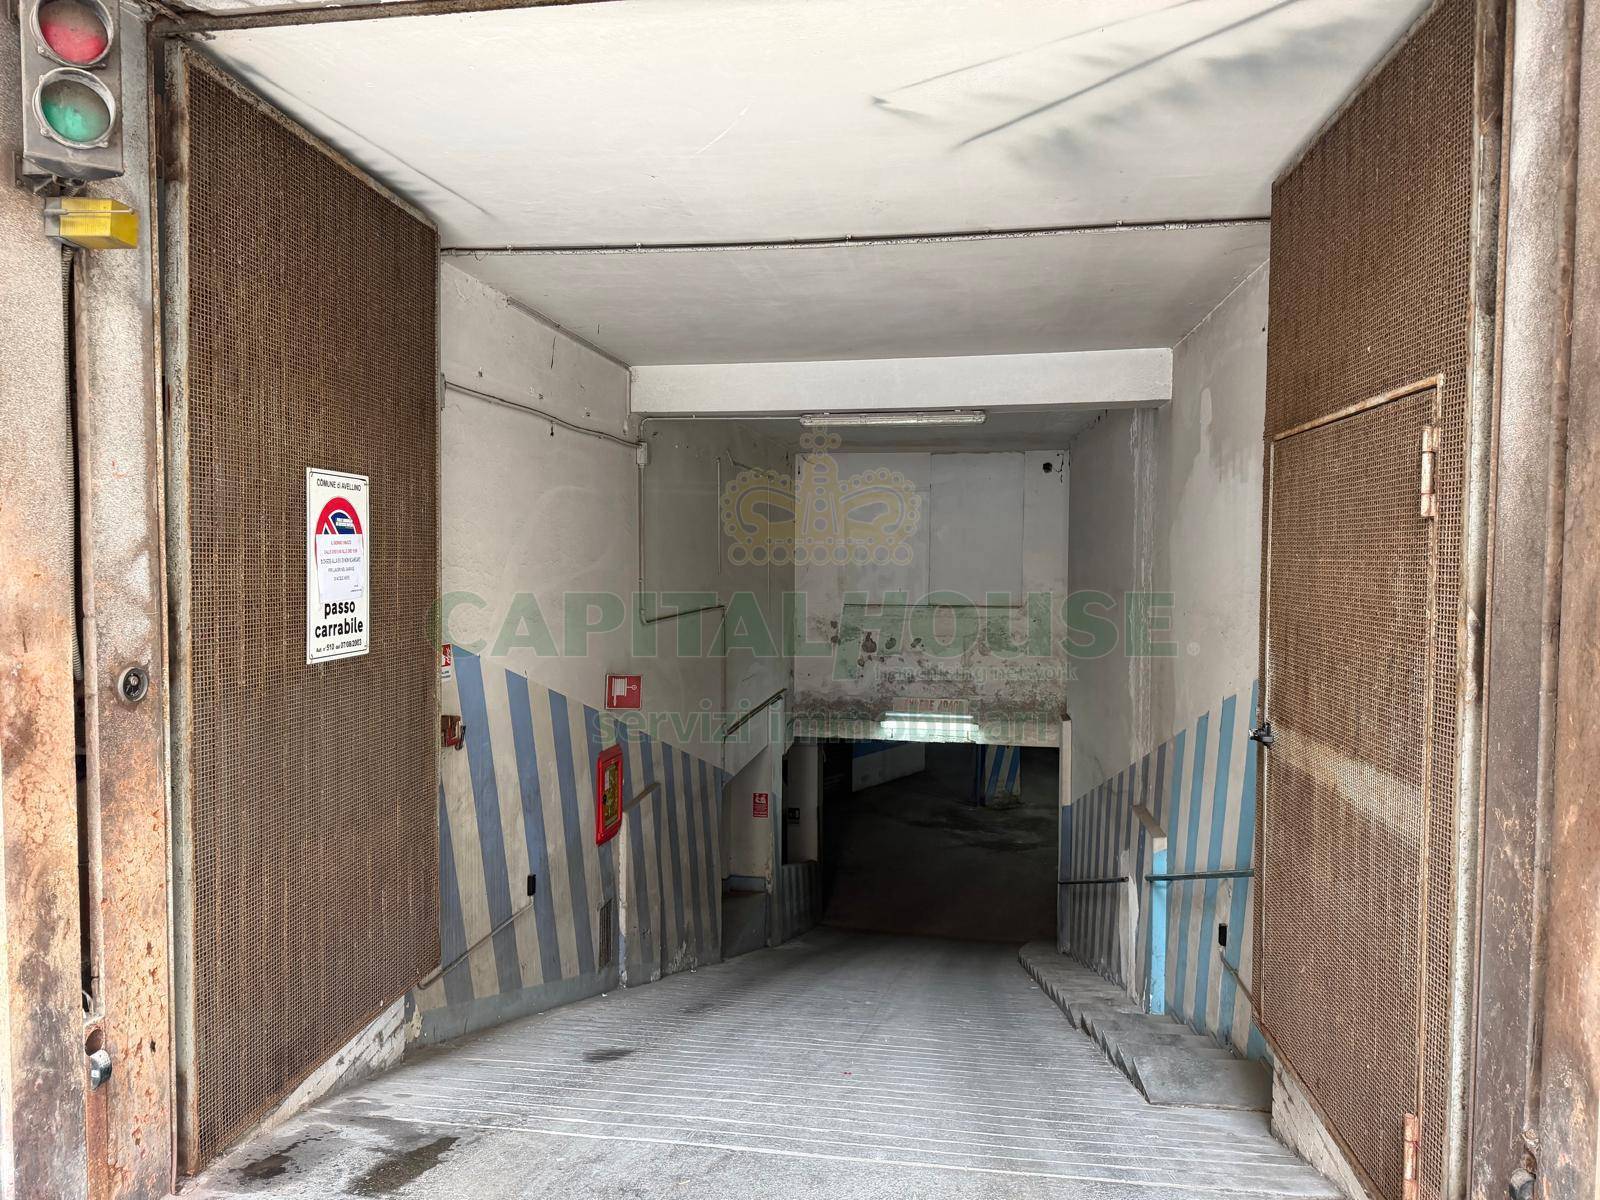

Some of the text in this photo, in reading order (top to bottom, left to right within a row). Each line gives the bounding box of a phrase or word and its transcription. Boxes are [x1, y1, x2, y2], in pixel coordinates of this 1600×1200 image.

[316, 478, 336, 488] COMUNE
[341, 482, 362, 492] AVELLINO
[324, 601, 356, 620] passo
[314, 616, 364, 638] carrabile
